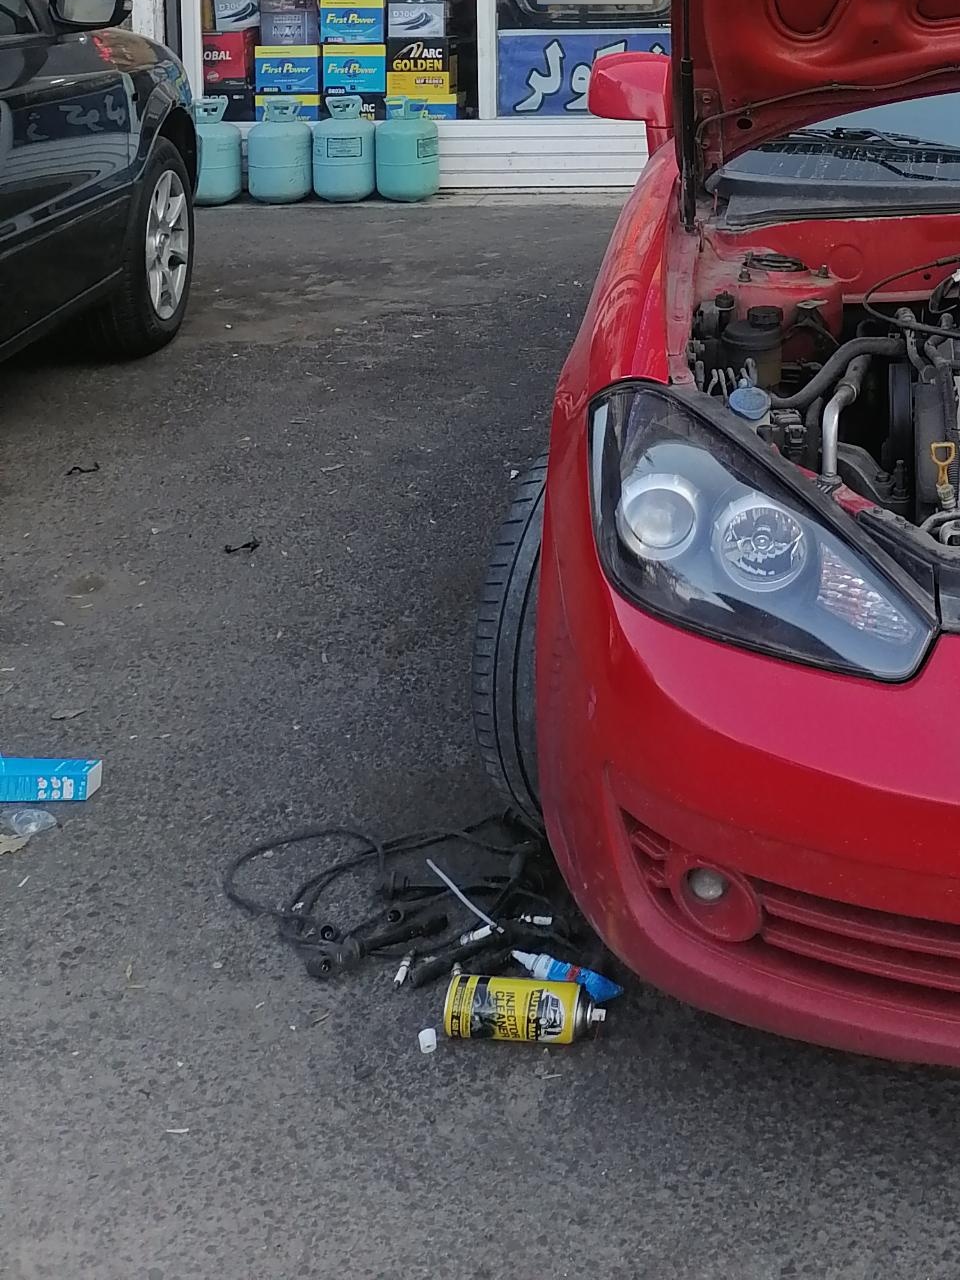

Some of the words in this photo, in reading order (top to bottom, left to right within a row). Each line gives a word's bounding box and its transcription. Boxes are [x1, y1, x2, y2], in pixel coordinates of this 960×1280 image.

[326, 13, 348, 24] First
[348, 13, 376, 24] Power
[203, 50, 232, 60] OBAL
[261, 63, 282, 74] First
[283, 62, 310, 74] Power
[327, 63, 348, 74] First
[349, 62, 377, 74] Power
[392, 59, 443, 71] GOLDEN
[513, 38, 628, 112] ولر
[495, 990, 510, 1038] CLEANER
[505, 991, 521, 1039] INJECTOR
